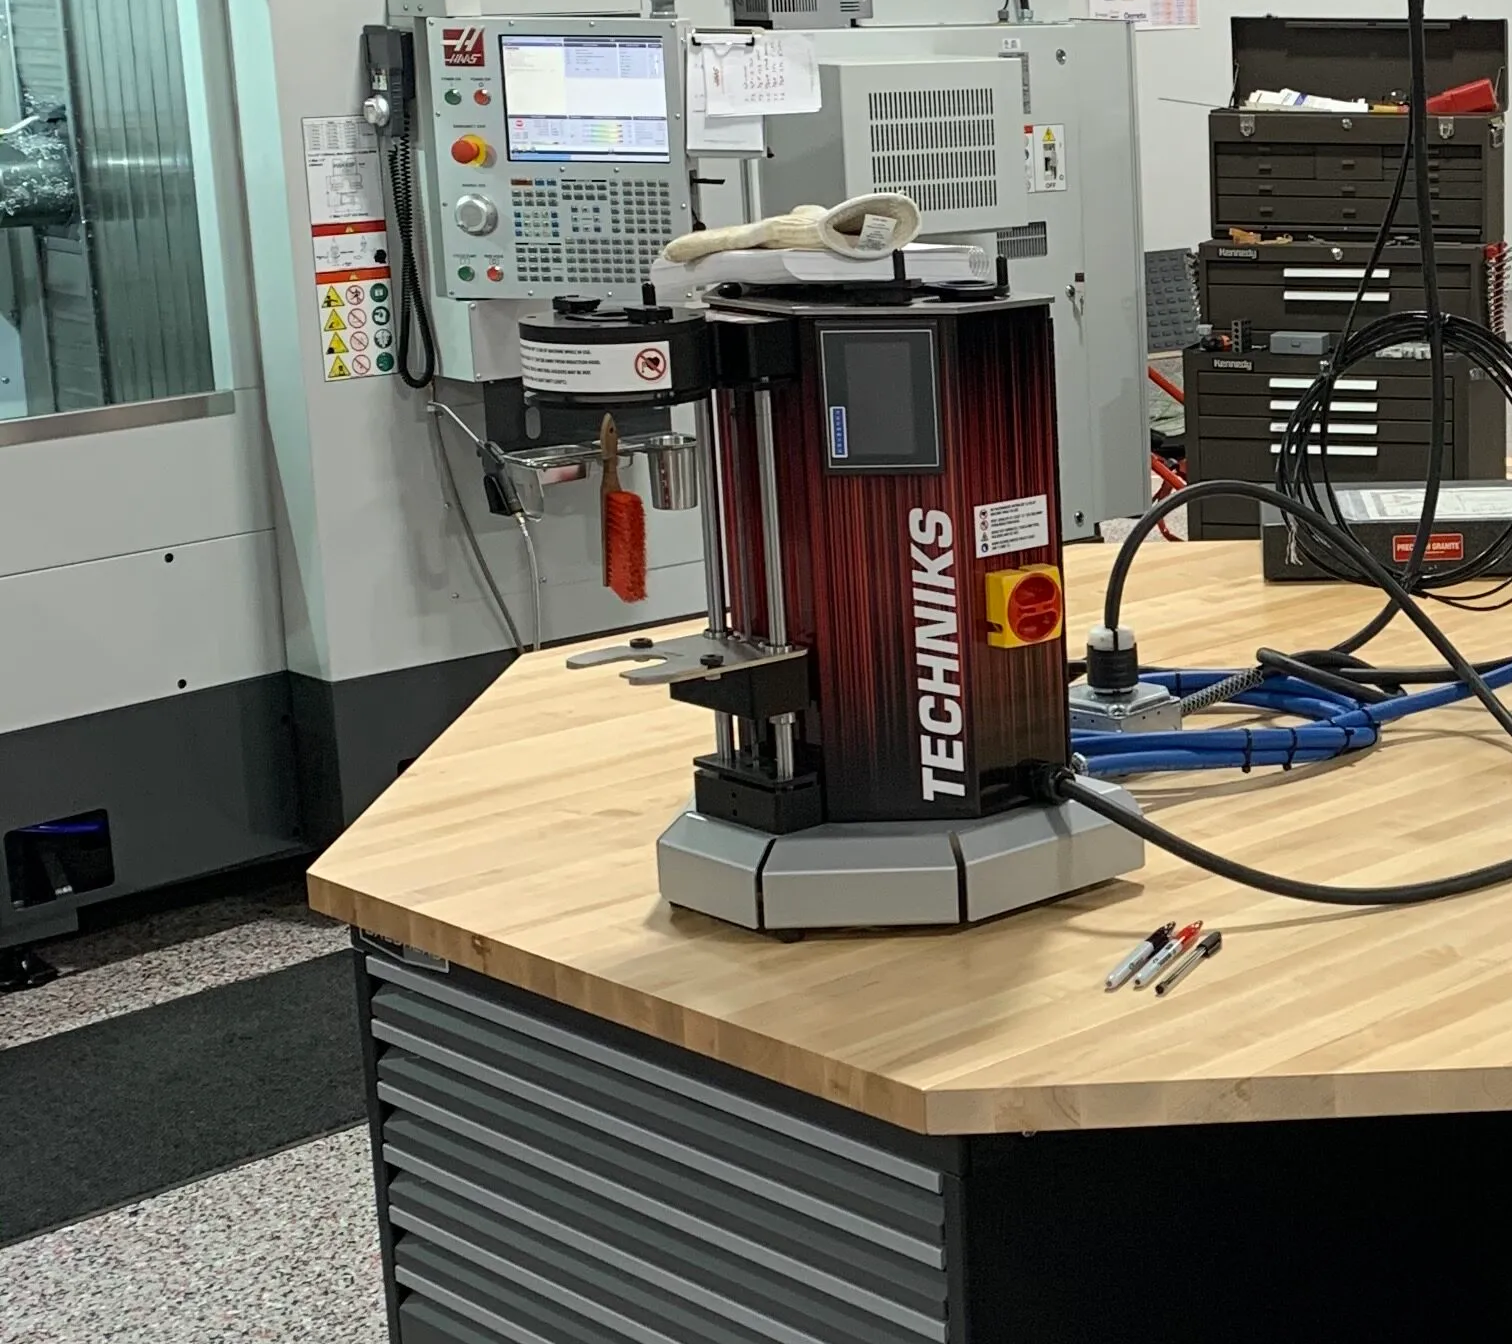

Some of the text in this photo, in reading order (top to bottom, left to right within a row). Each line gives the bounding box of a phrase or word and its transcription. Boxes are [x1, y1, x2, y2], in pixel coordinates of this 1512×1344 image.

[1218, 248, 1258, 260] Kennedy
[1213, 359, 1253, 371] Kennedy
[1431, 542, 1461, 551] GRANITE
[908, 507, 967, 802] TECHNIKS
